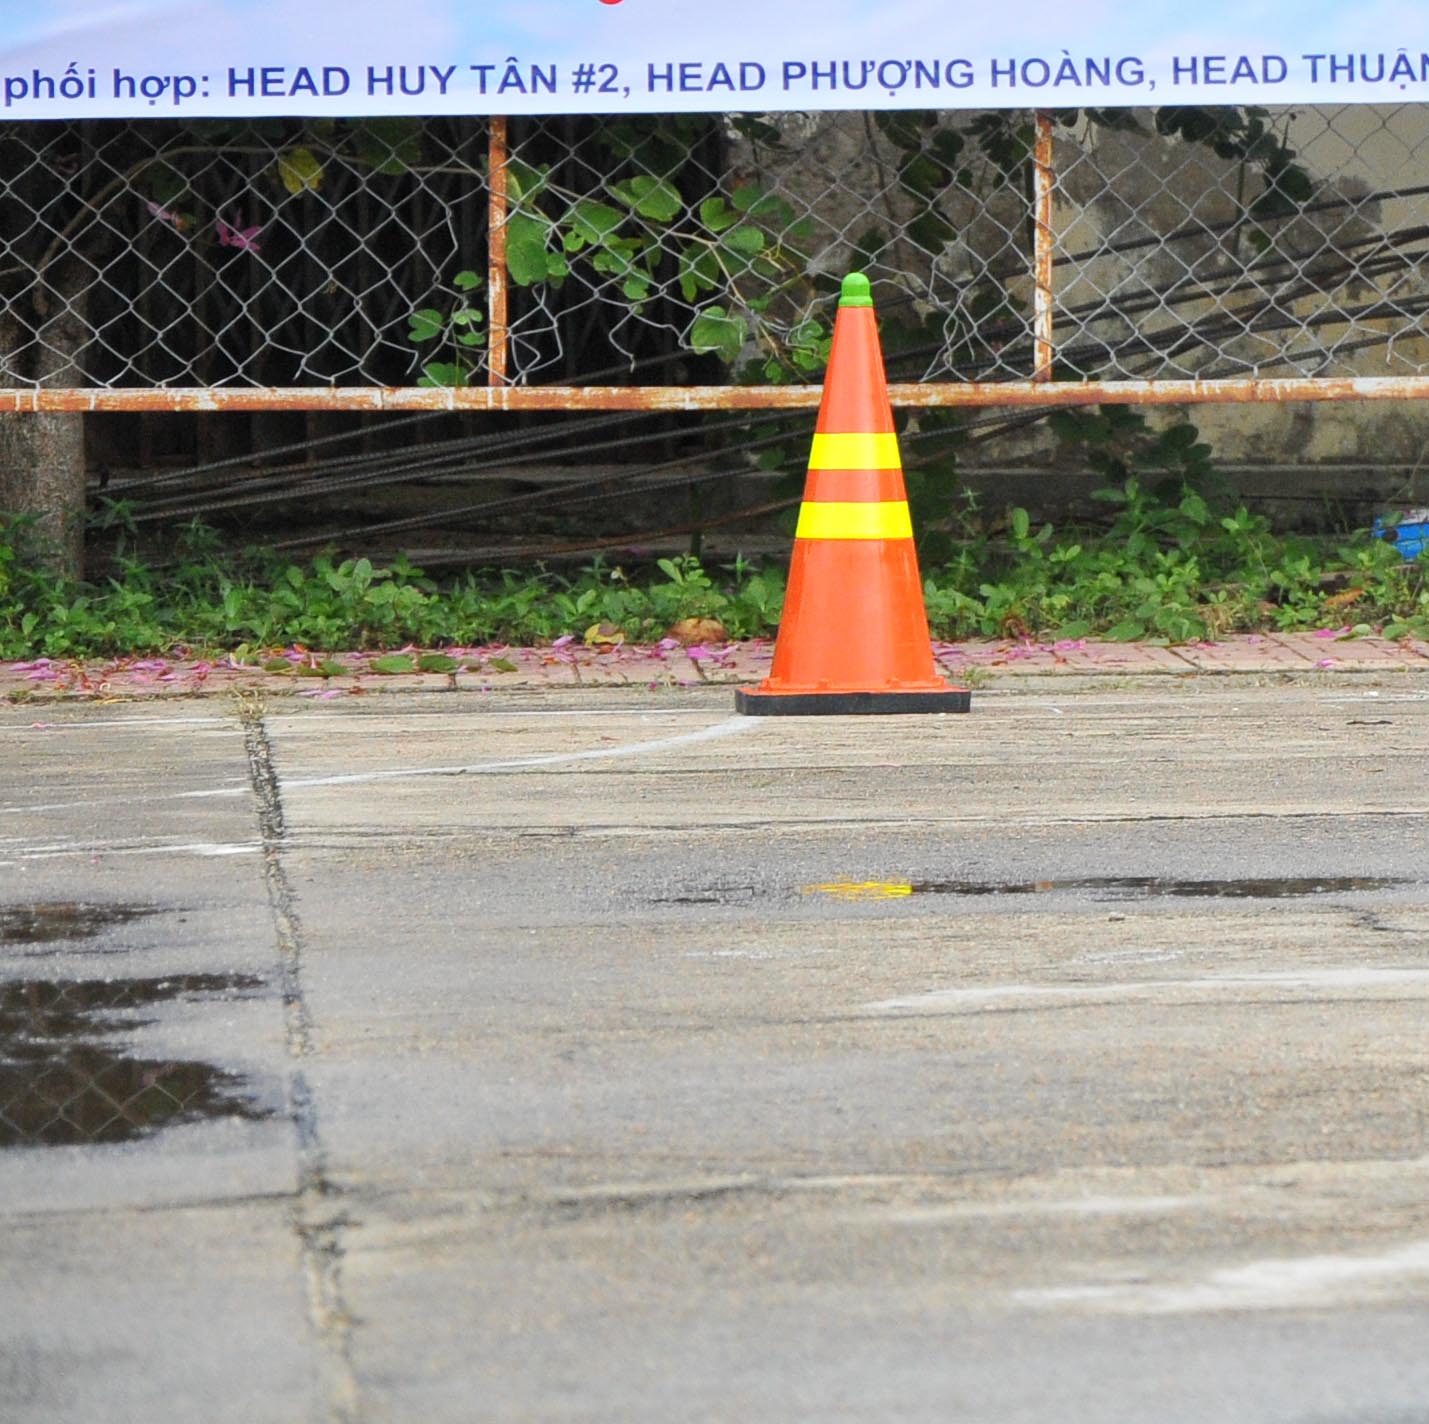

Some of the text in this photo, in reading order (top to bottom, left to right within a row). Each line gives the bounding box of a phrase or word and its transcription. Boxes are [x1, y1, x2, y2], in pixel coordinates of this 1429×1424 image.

[4, 62, 96, 107] phối
[112, 68, 210, 106] hợp:
[227, 66, 351, 97] HEAD
[366, 64, 458, 96] HUY
[469, 56, 557, 95] TÂN
[571, 62, 631, 98] #2,
[647, 61, 767, 93] HEAD
[782, 58, 975, 96] PHƯỢNG
[990, 50, 1156, 91] HOÀNG,
[1172, 54, 1288, 86] HEAD
